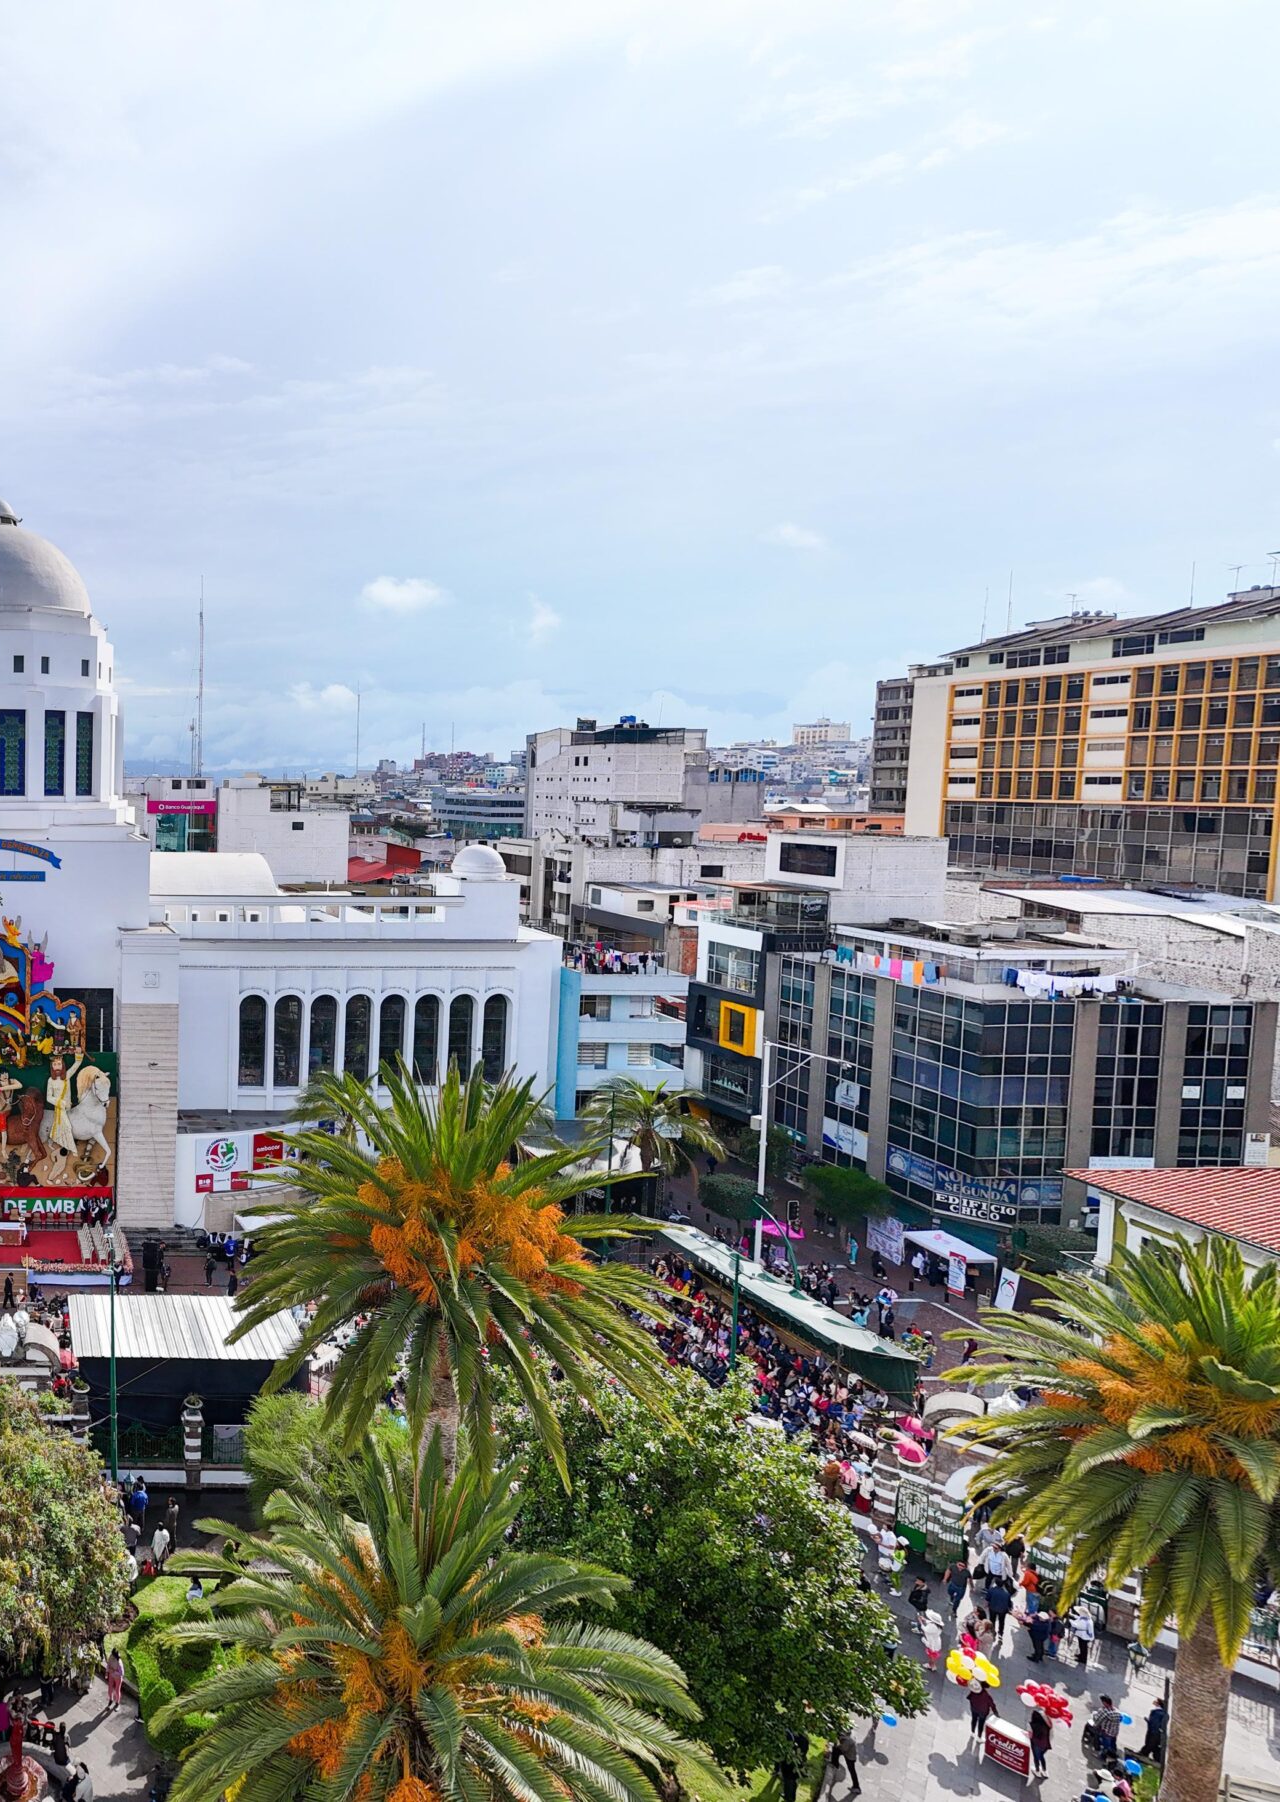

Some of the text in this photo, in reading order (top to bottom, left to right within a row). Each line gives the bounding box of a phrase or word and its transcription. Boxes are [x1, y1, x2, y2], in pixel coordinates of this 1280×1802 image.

[944, 1182, 1009, 1203] SEGUNDA
[4, 1200, 27, 1214] DE
[935, 1193, 1016, 1216] EDIFICIO
[949, 1205, 1000, 1221] CHICO
